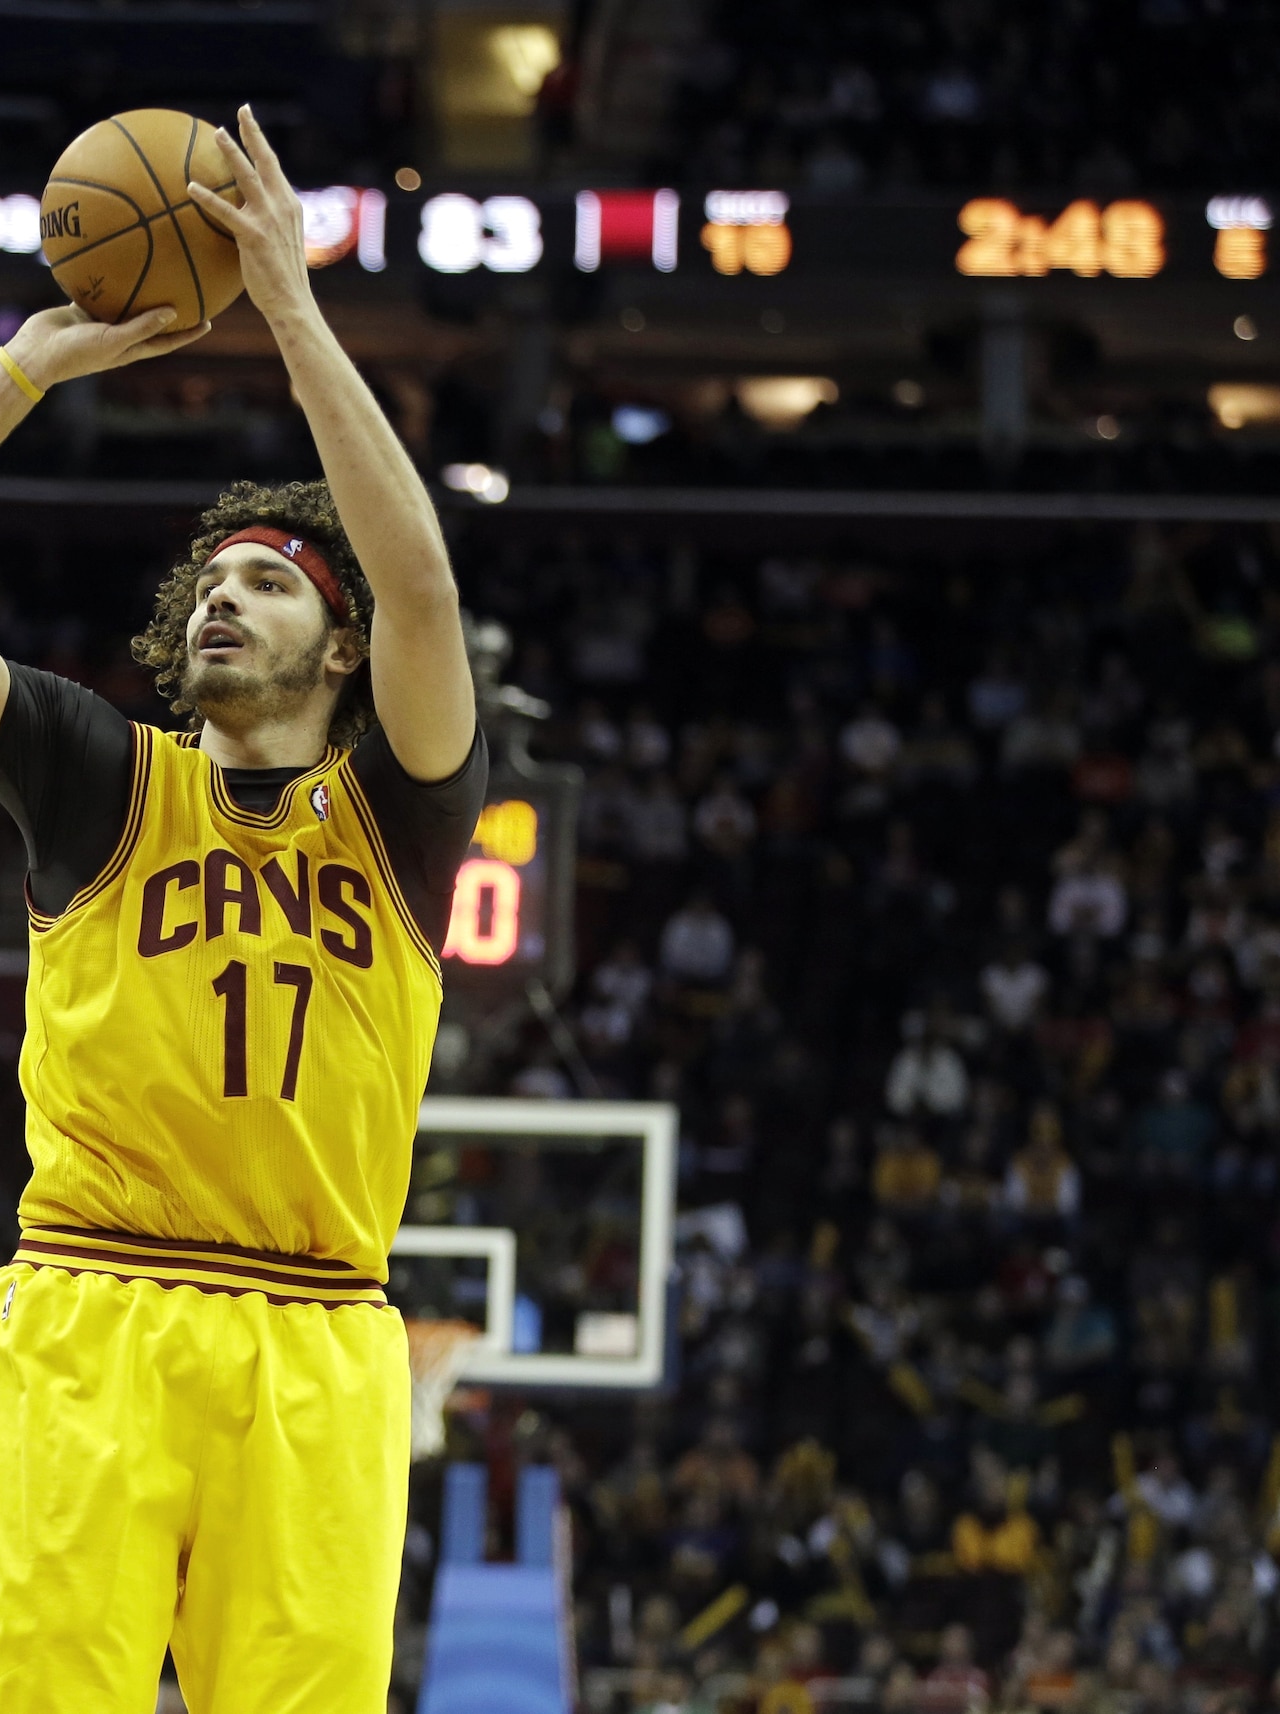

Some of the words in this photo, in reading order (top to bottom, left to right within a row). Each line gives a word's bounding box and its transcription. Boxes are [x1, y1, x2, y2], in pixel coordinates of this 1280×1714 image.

[417, 192, 544, 274] 83
[137, 848, 374, 968] CAVS
[211, 959, 314, 1102] 17
